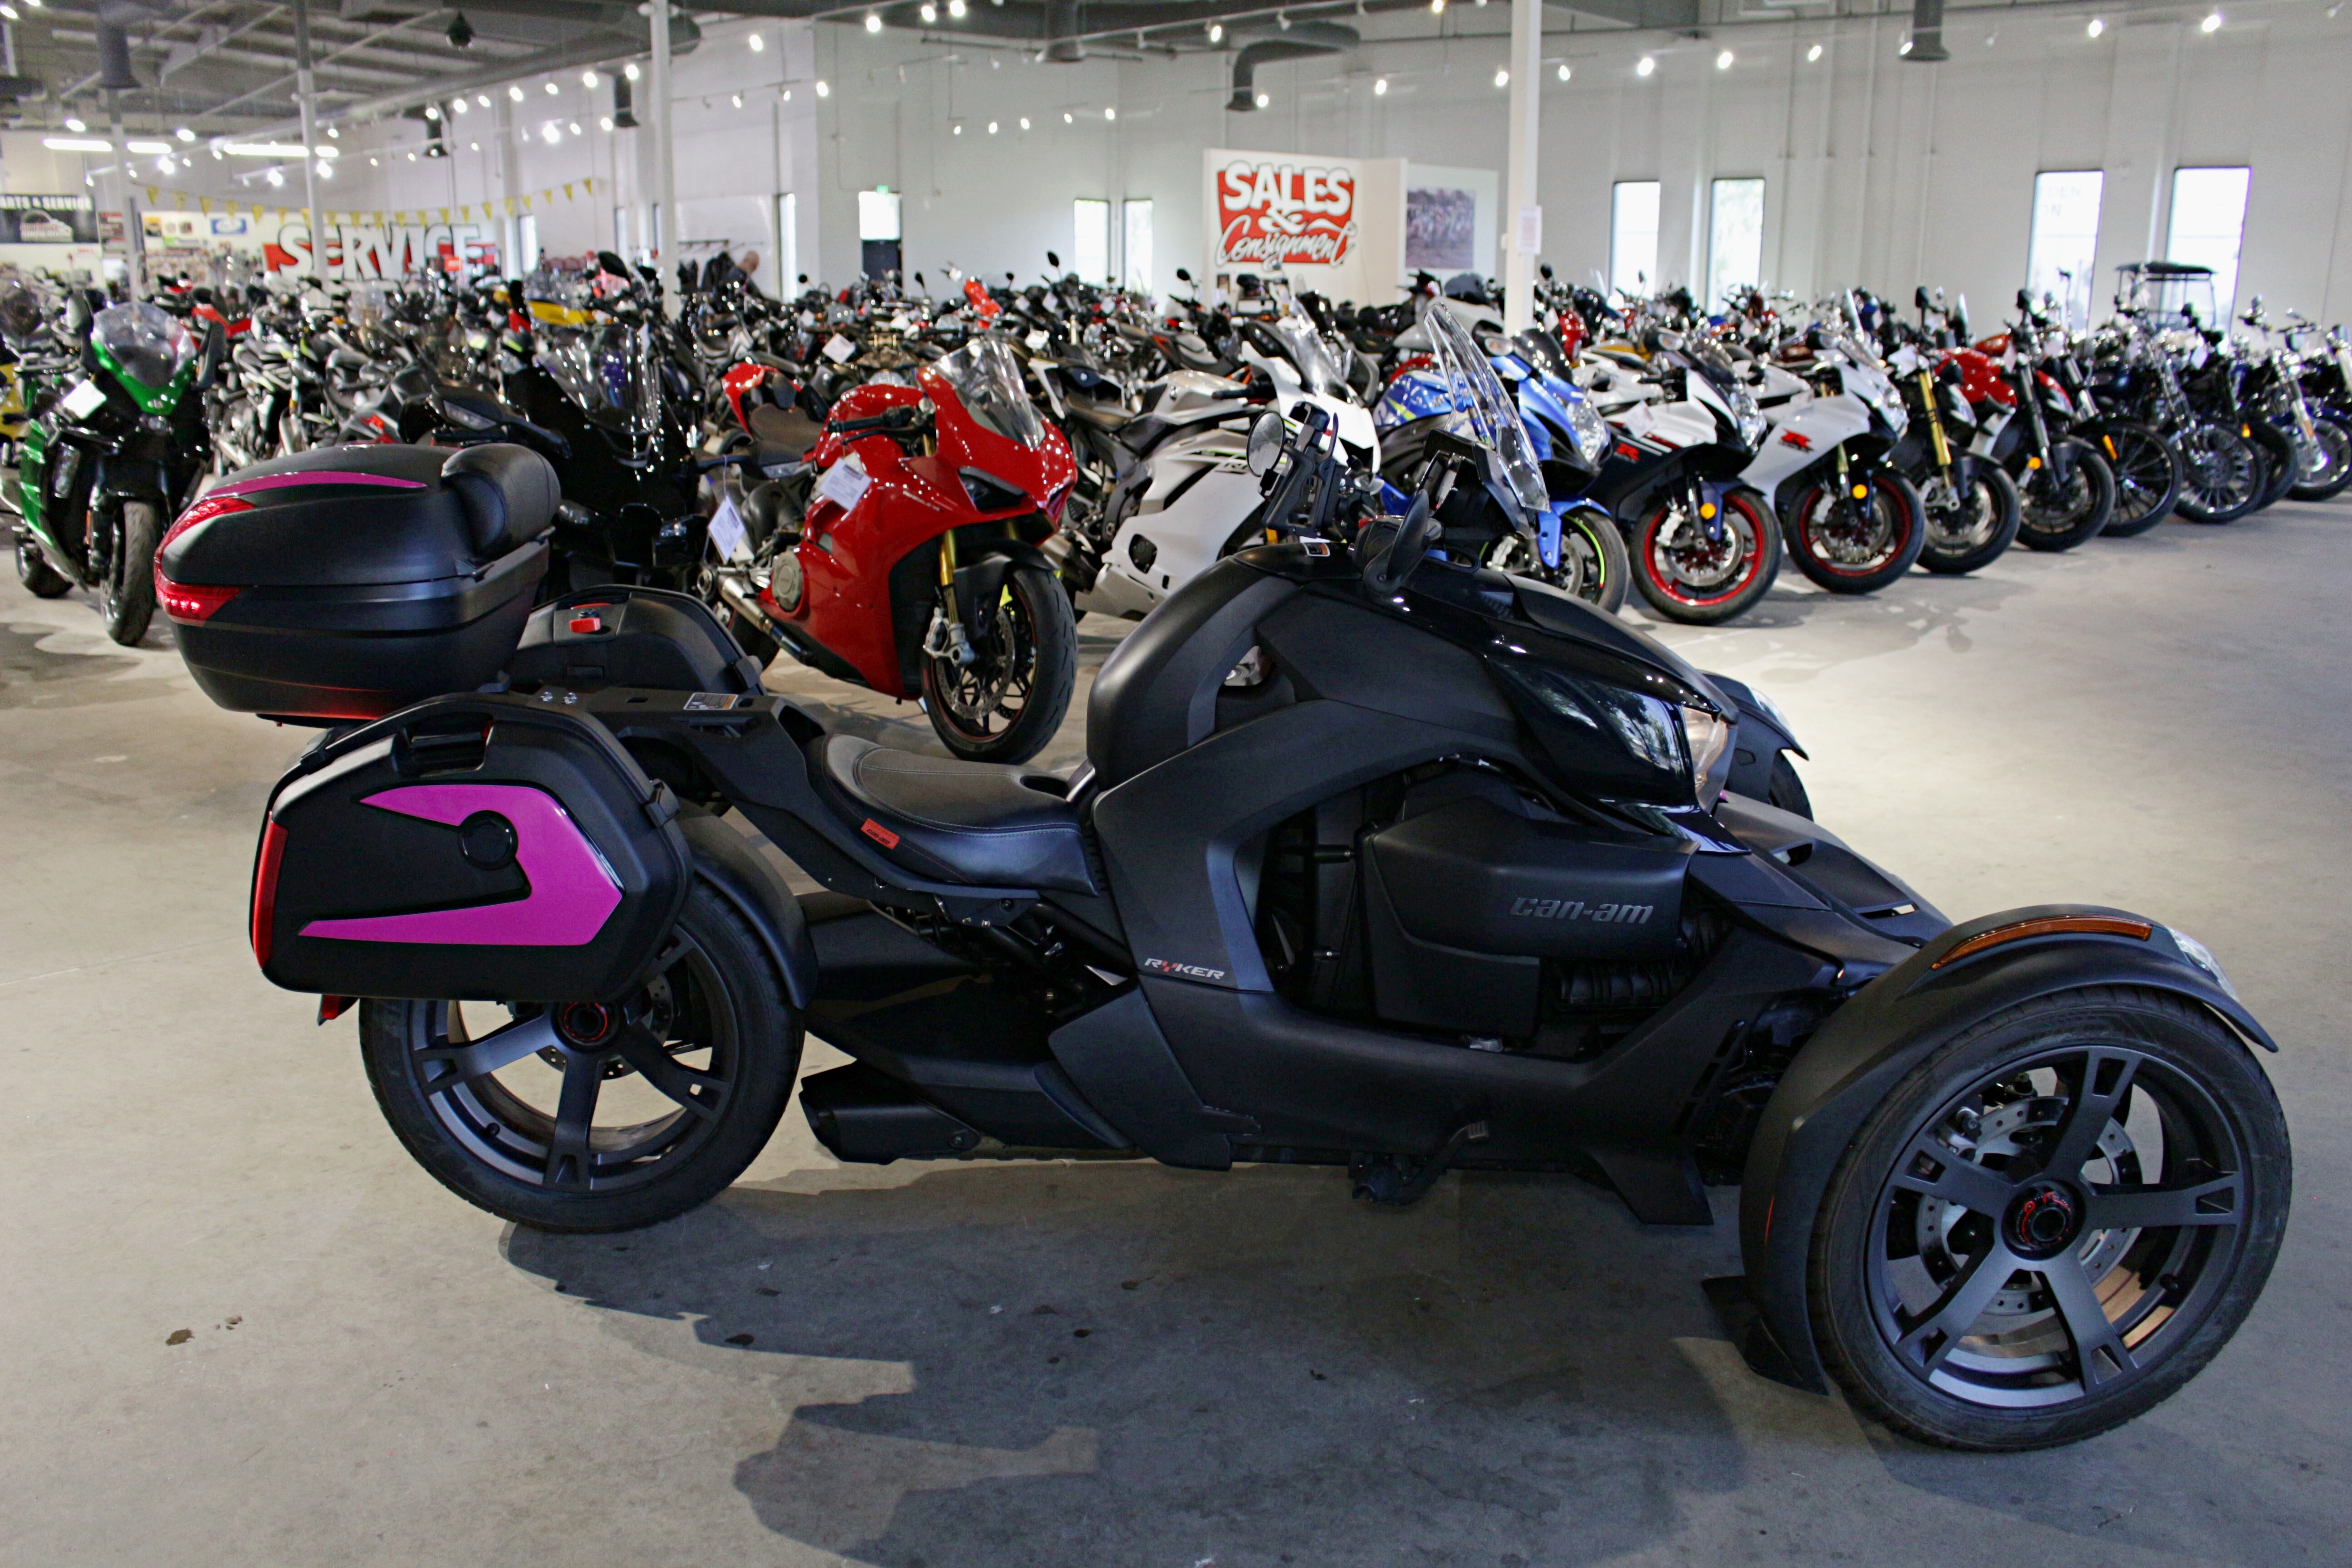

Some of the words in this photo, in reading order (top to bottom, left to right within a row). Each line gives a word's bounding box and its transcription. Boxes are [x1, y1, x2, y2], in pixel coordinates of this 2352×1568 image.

[1222, 160, 1352, 216] SALES
[1215, 214, 1357, 271] Consignment
[1509, 897, 1654, 924] can-am
[1144, 958, 1225, 980] RYKER
